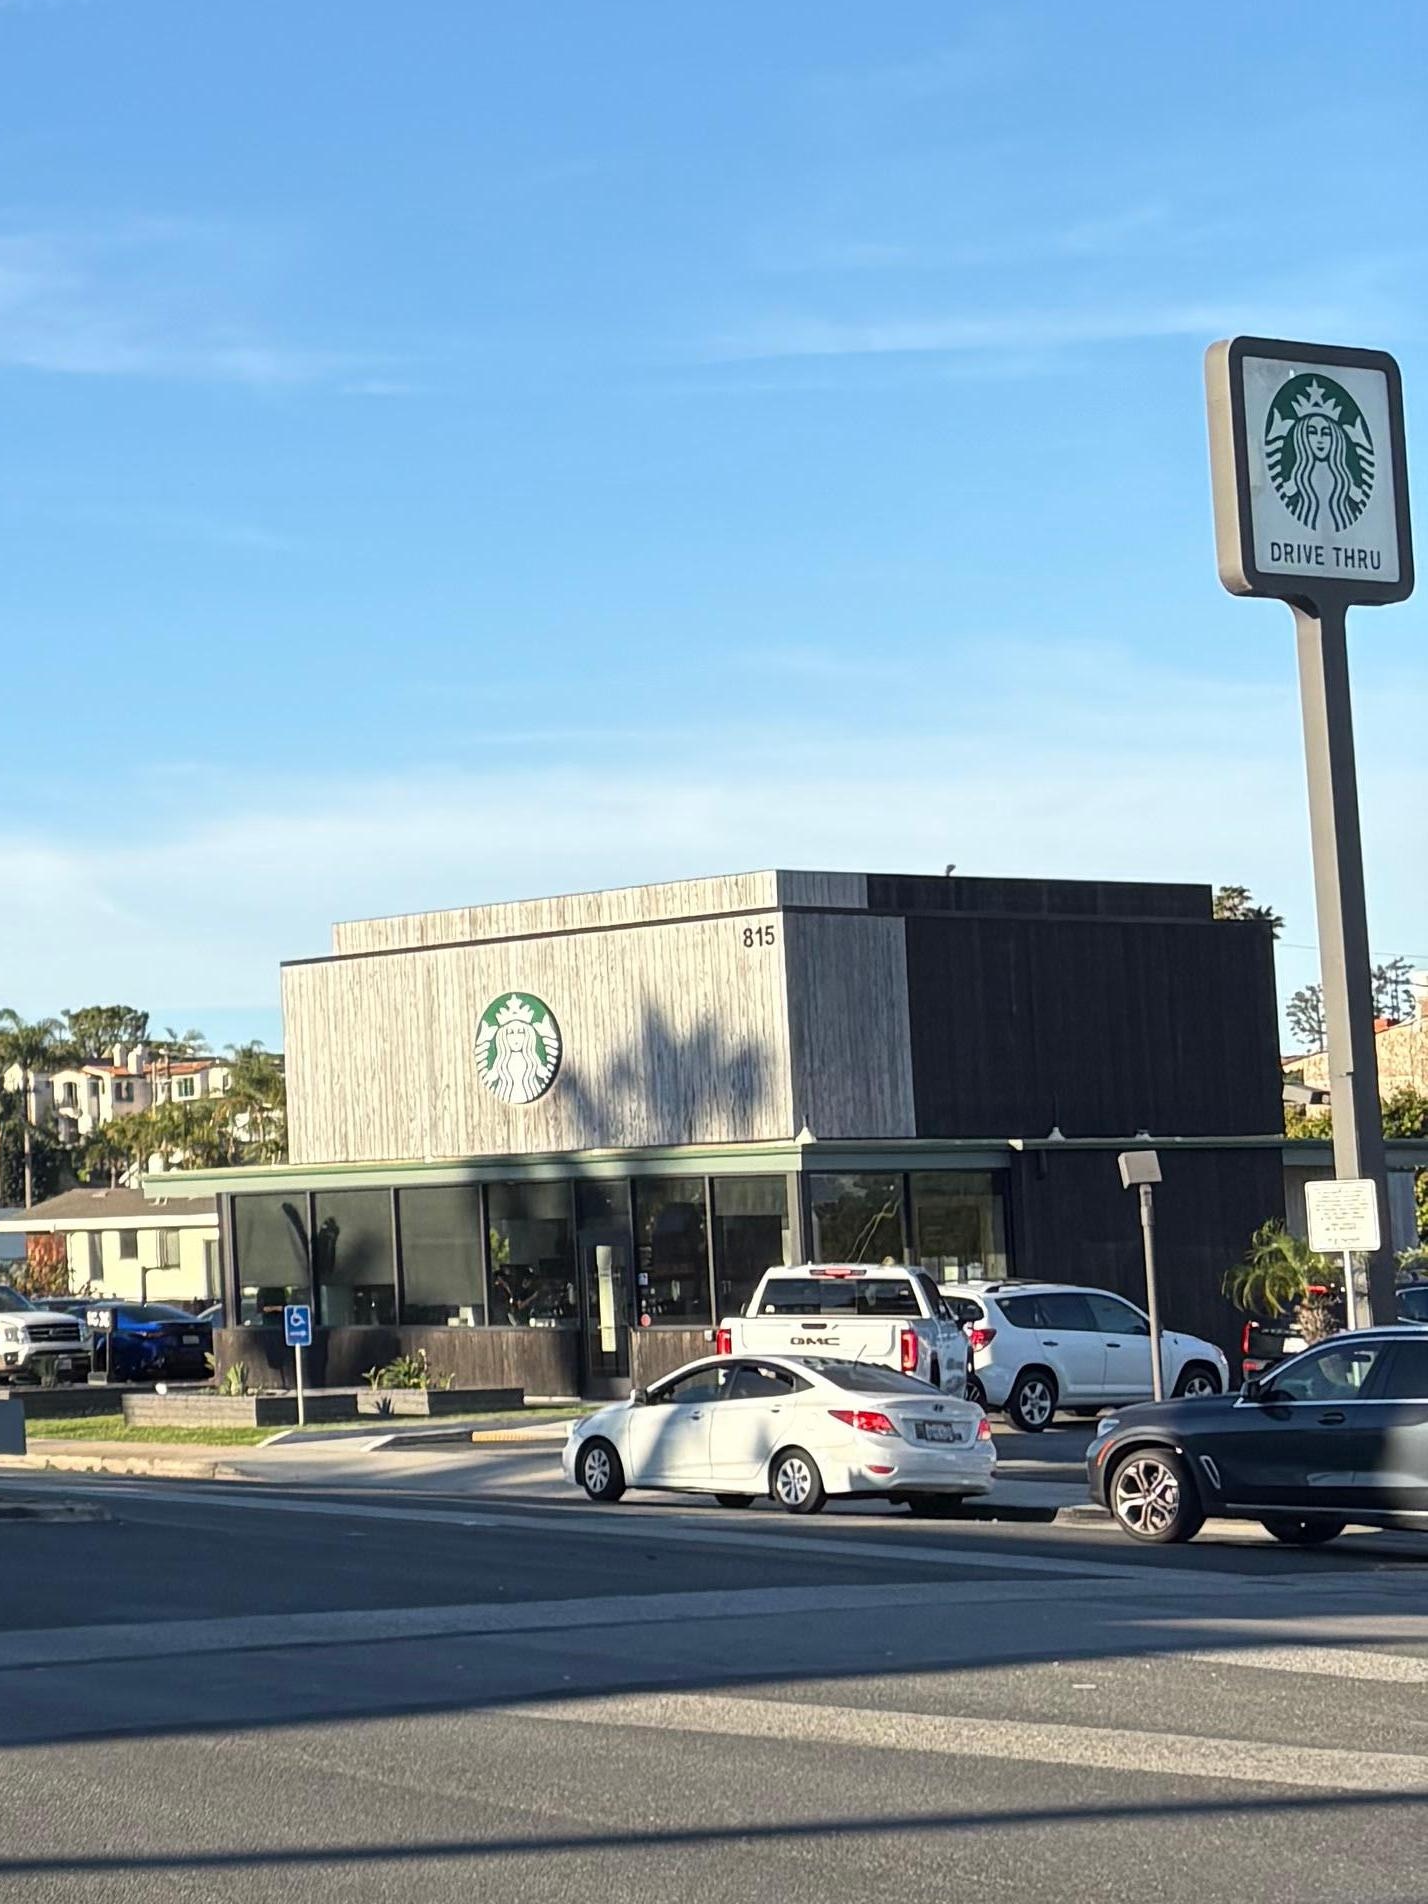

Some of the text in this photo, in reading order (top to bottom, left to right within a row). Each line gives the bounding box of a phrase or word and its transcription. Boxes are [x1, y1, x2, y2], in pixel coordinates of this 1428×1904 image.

[1270, 542, 1381, 570] DRIVE THRU
[743, 924, 775, 948] 815
